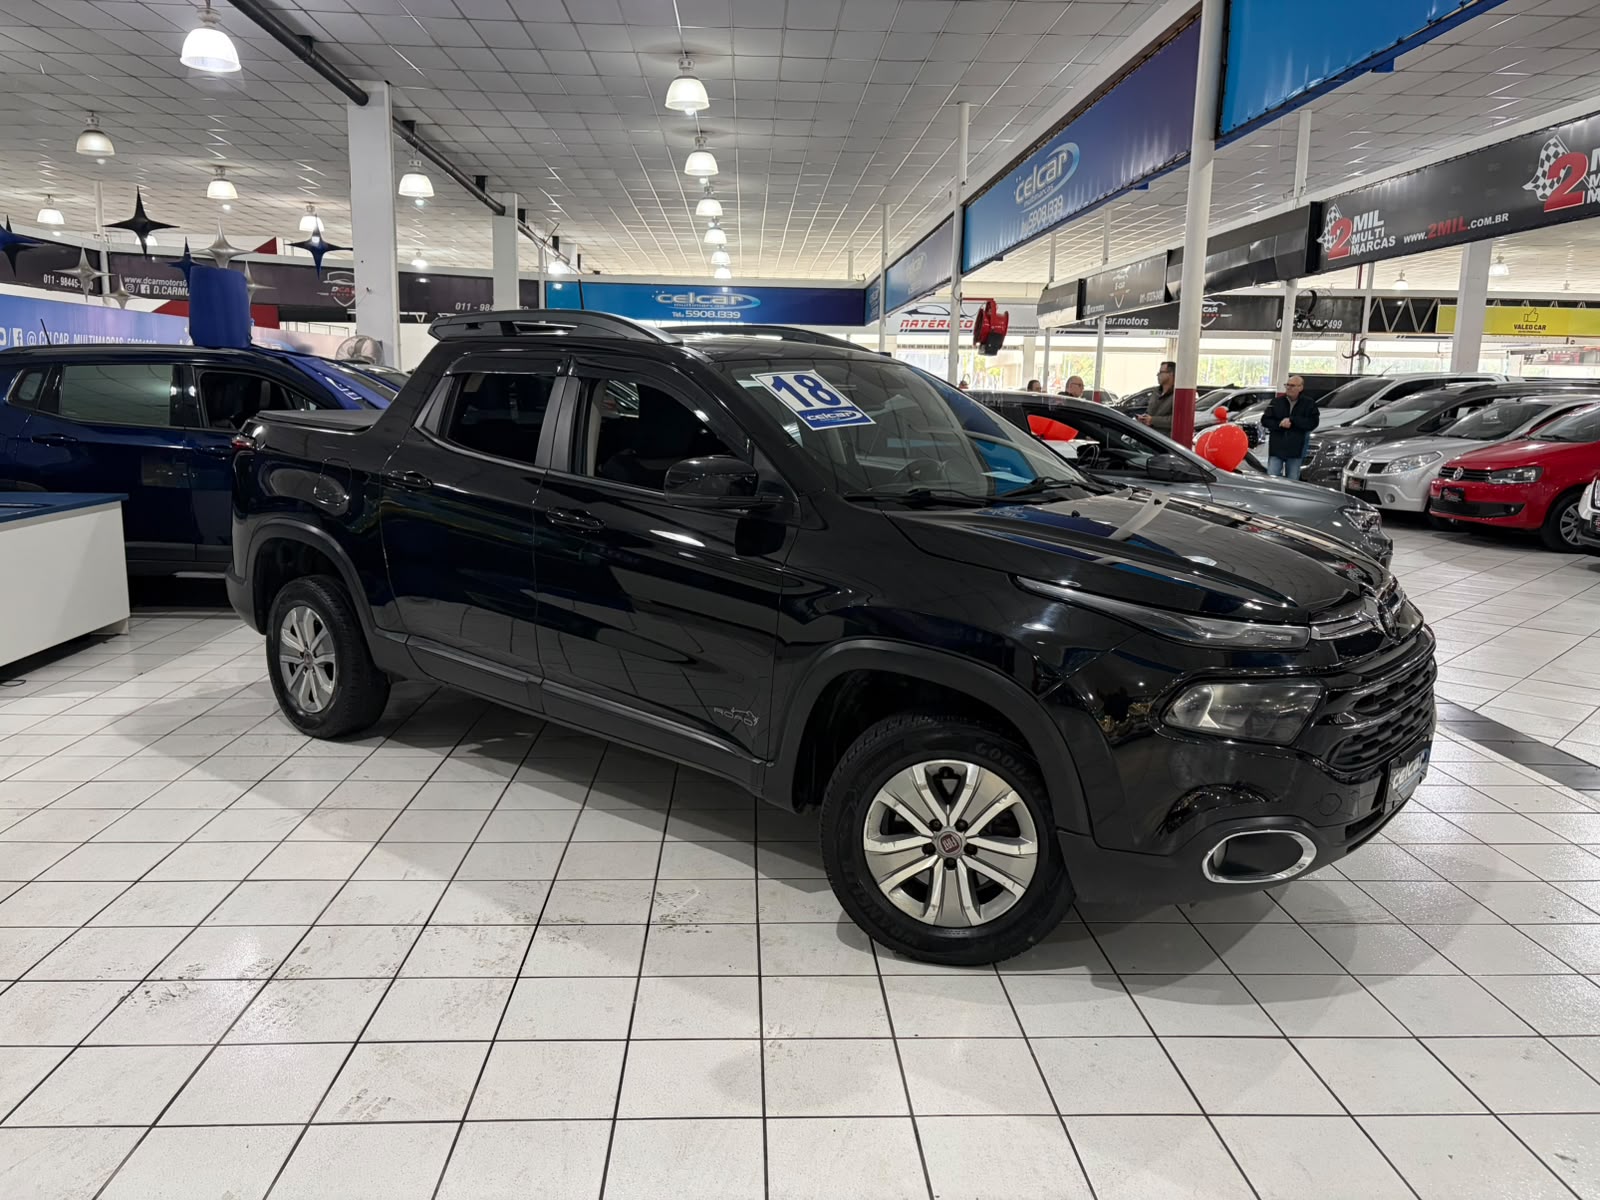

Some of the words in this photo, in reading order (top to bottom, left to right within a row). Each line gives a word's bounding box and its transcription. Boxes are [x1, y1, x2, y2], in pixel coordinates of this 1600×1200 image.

[1015, 151, 1068, 205] celcar
[1543, 151, 1589, 213] 2
[1353, 209, 1385, 233] MIL
[1327, 216, 1353, 261] 2
[1350, 235, 1396, 256] MARCAS
[1351, 226, 1386, 244] MULTI
[43, 273, 55, 285] 011
[655, 292, 744, 306] celcar
[771, 374, 842, 409] 18
[807, 411, 854, 422] celcar
